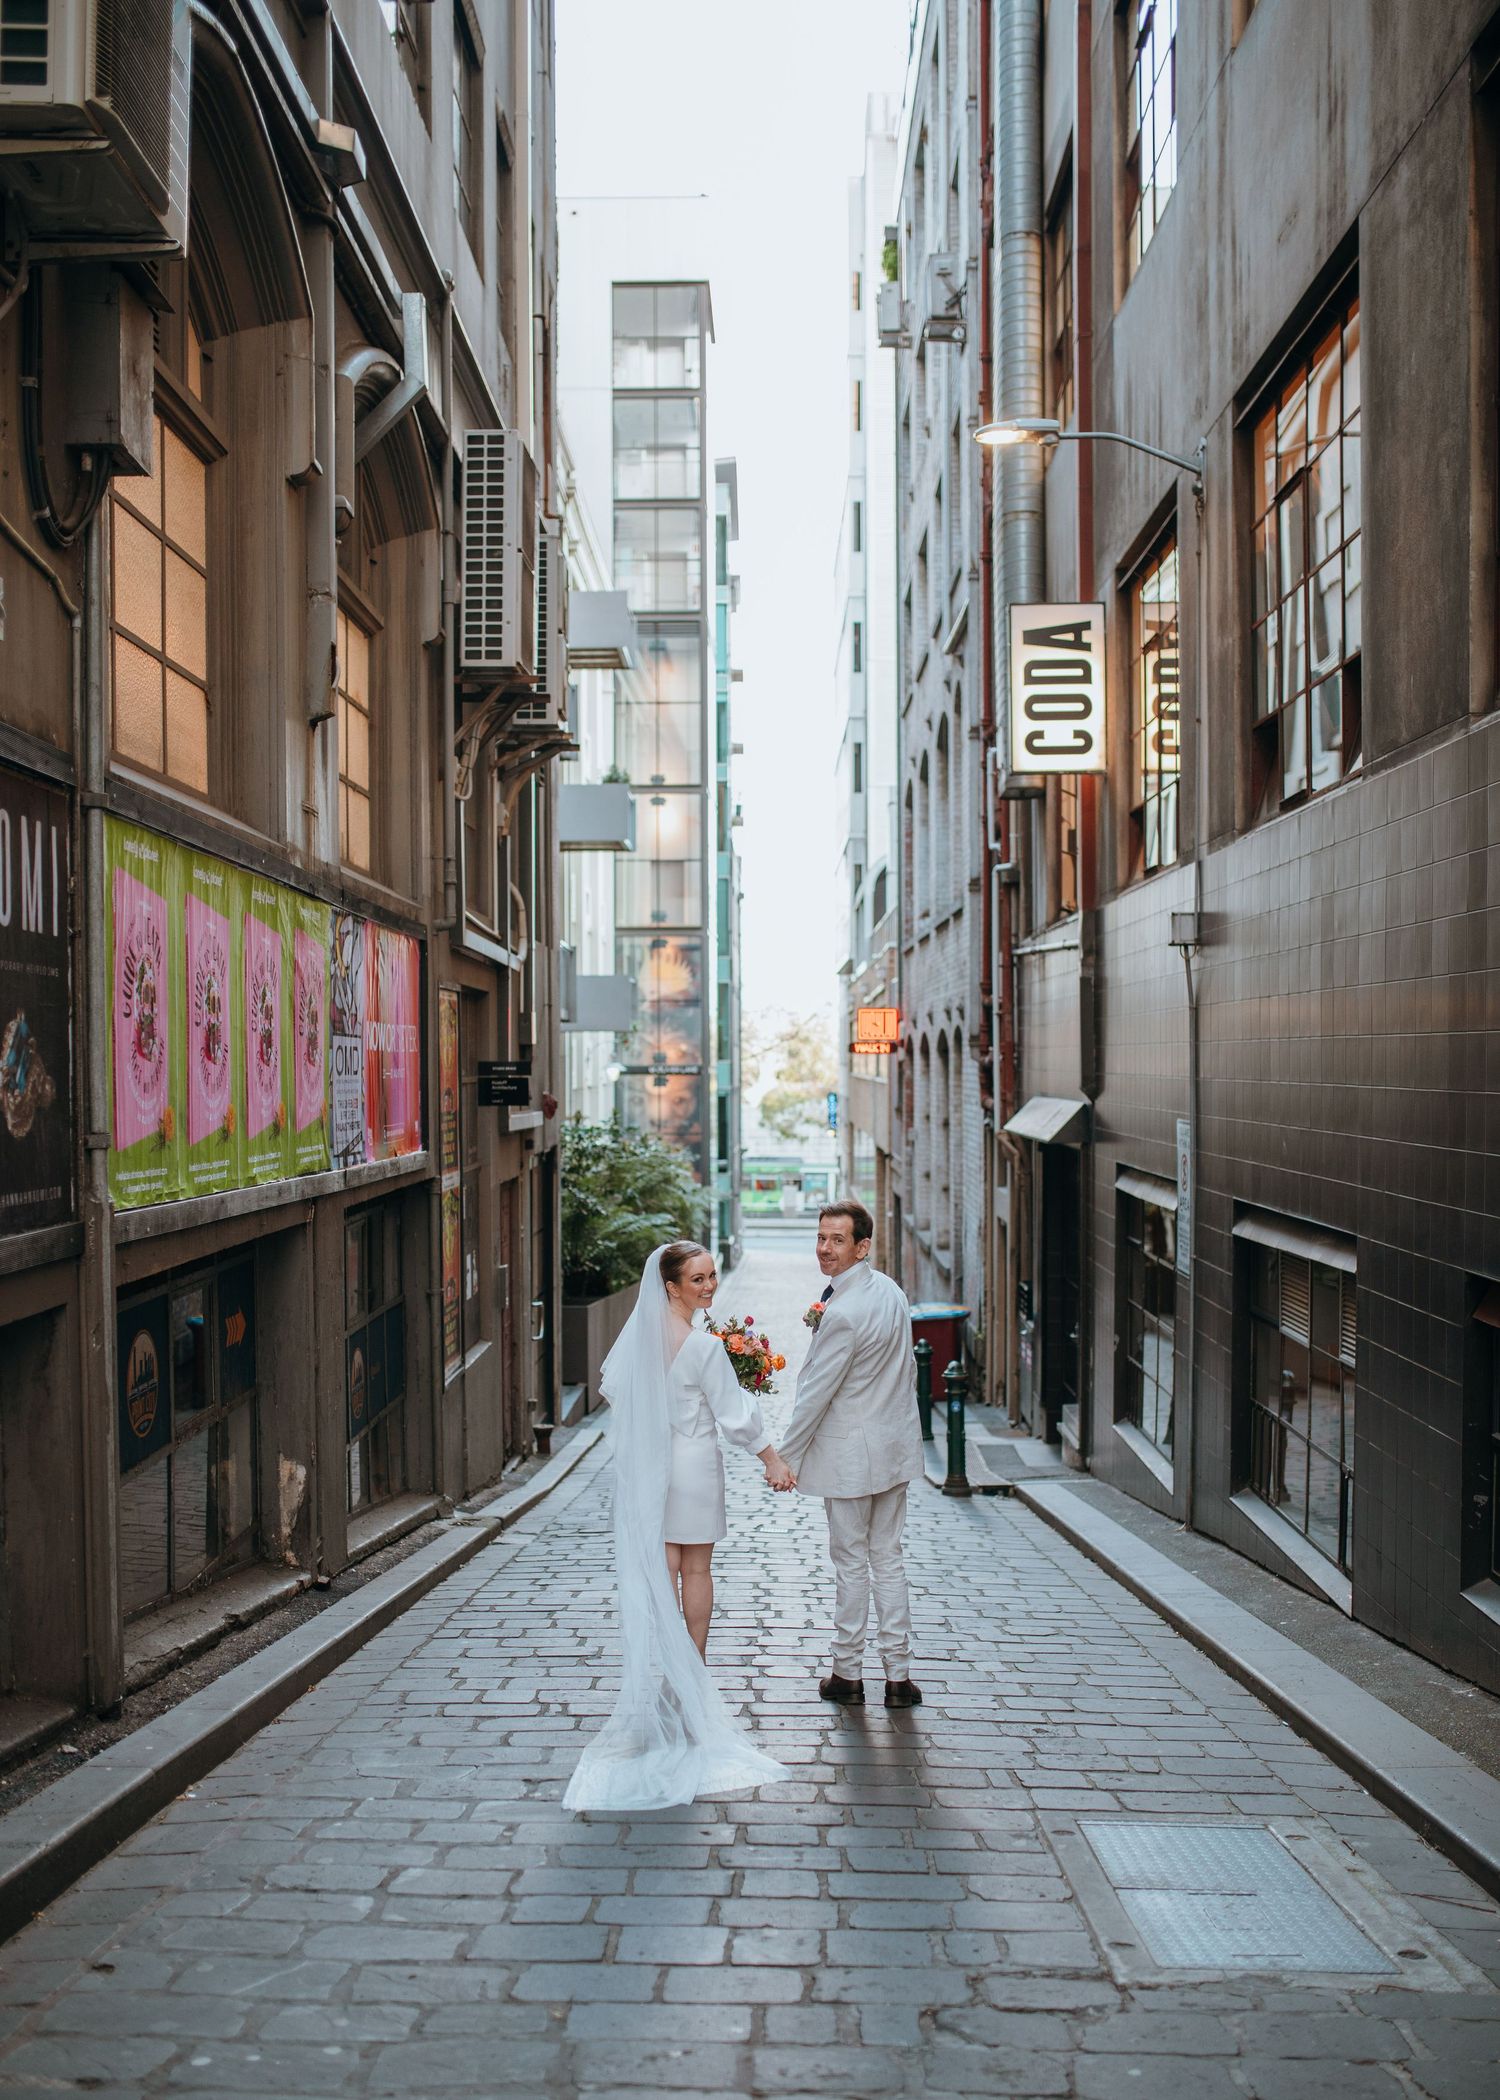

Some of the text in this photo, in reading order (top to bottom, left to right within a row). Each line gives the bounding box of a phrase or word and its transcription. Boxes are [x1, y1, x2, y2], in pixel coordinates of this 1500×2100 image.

[1023, 621, 1093, 755] CODA
[0, 808, 58, 937] OMI
[335, 1044, 360, 1076] OMD
